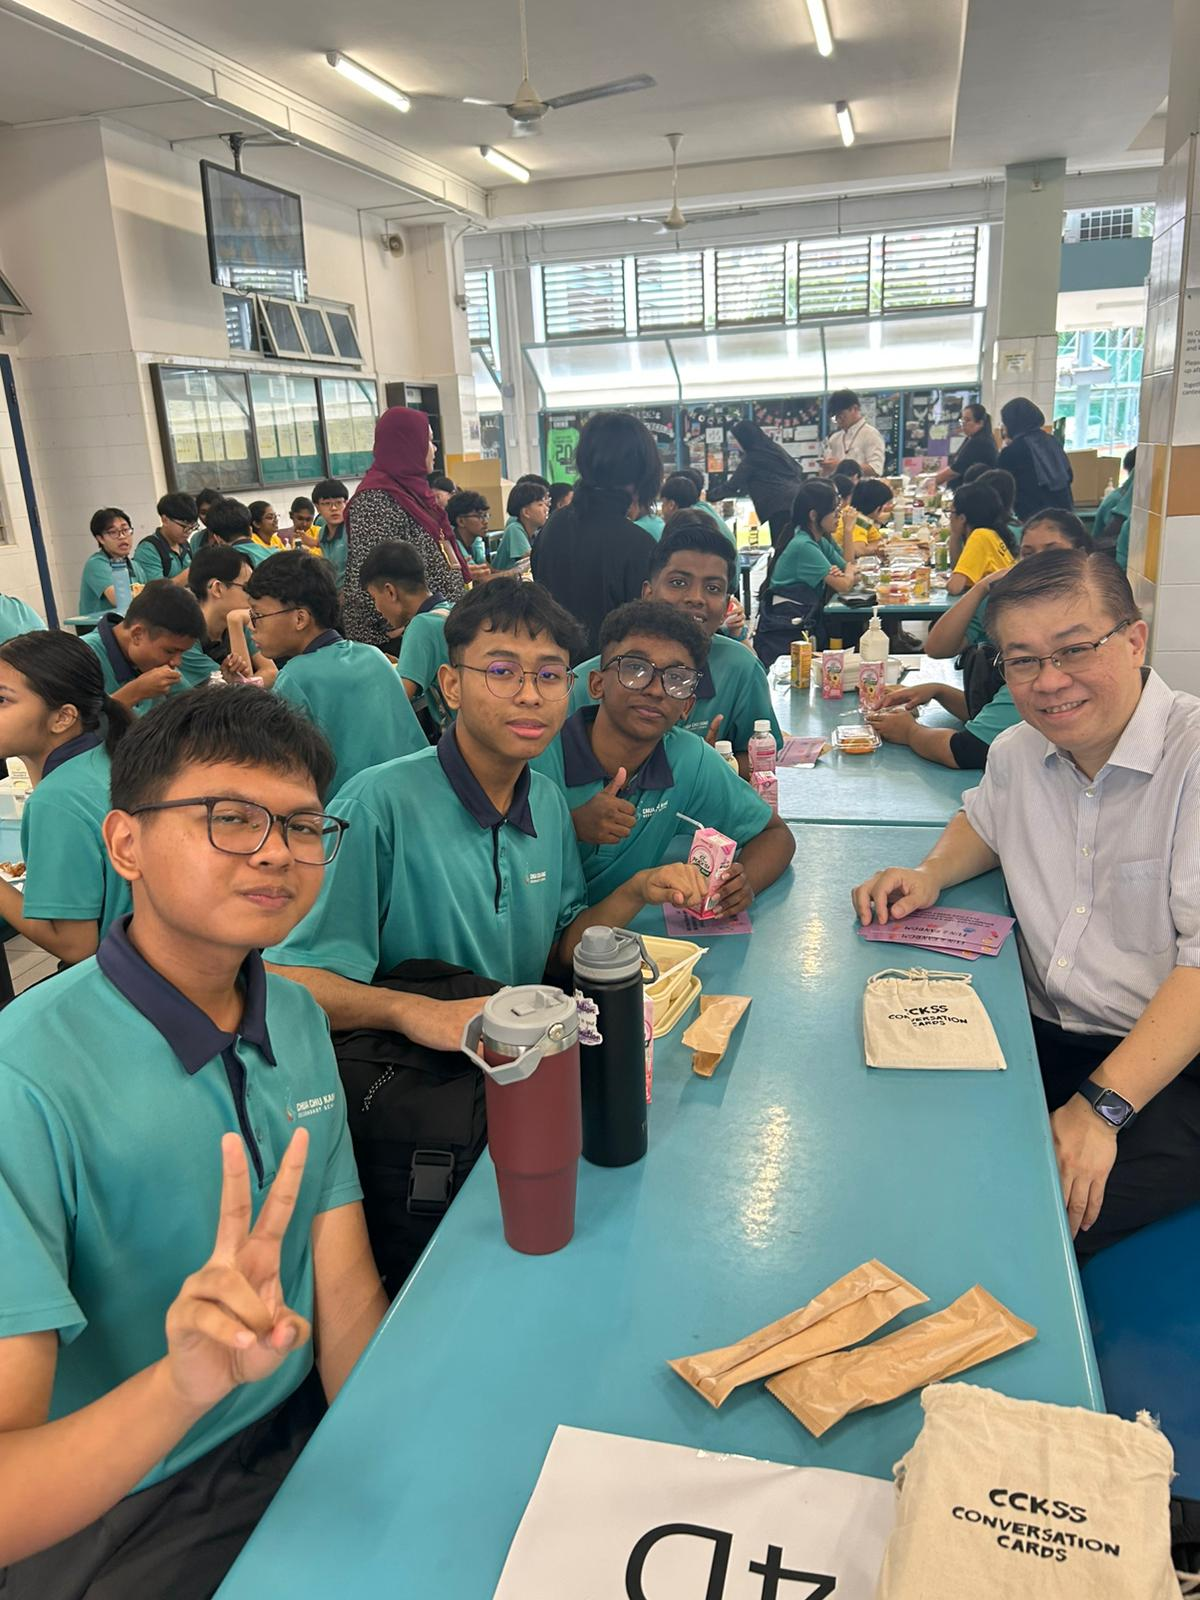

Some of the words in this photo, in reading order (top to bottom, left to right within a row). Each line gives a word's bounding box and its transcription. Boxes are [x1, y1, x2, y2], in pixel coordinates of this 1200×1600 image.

[904, 1005, 948, 1015] CKSS
[988, 1488, 1088, 1524] CCKSS
[951, 1506, 1121, 1557] CONVERSATION
[996, 1535, 1068, 1563] CARDS
[625, 1522, 837, 1600] 4D
